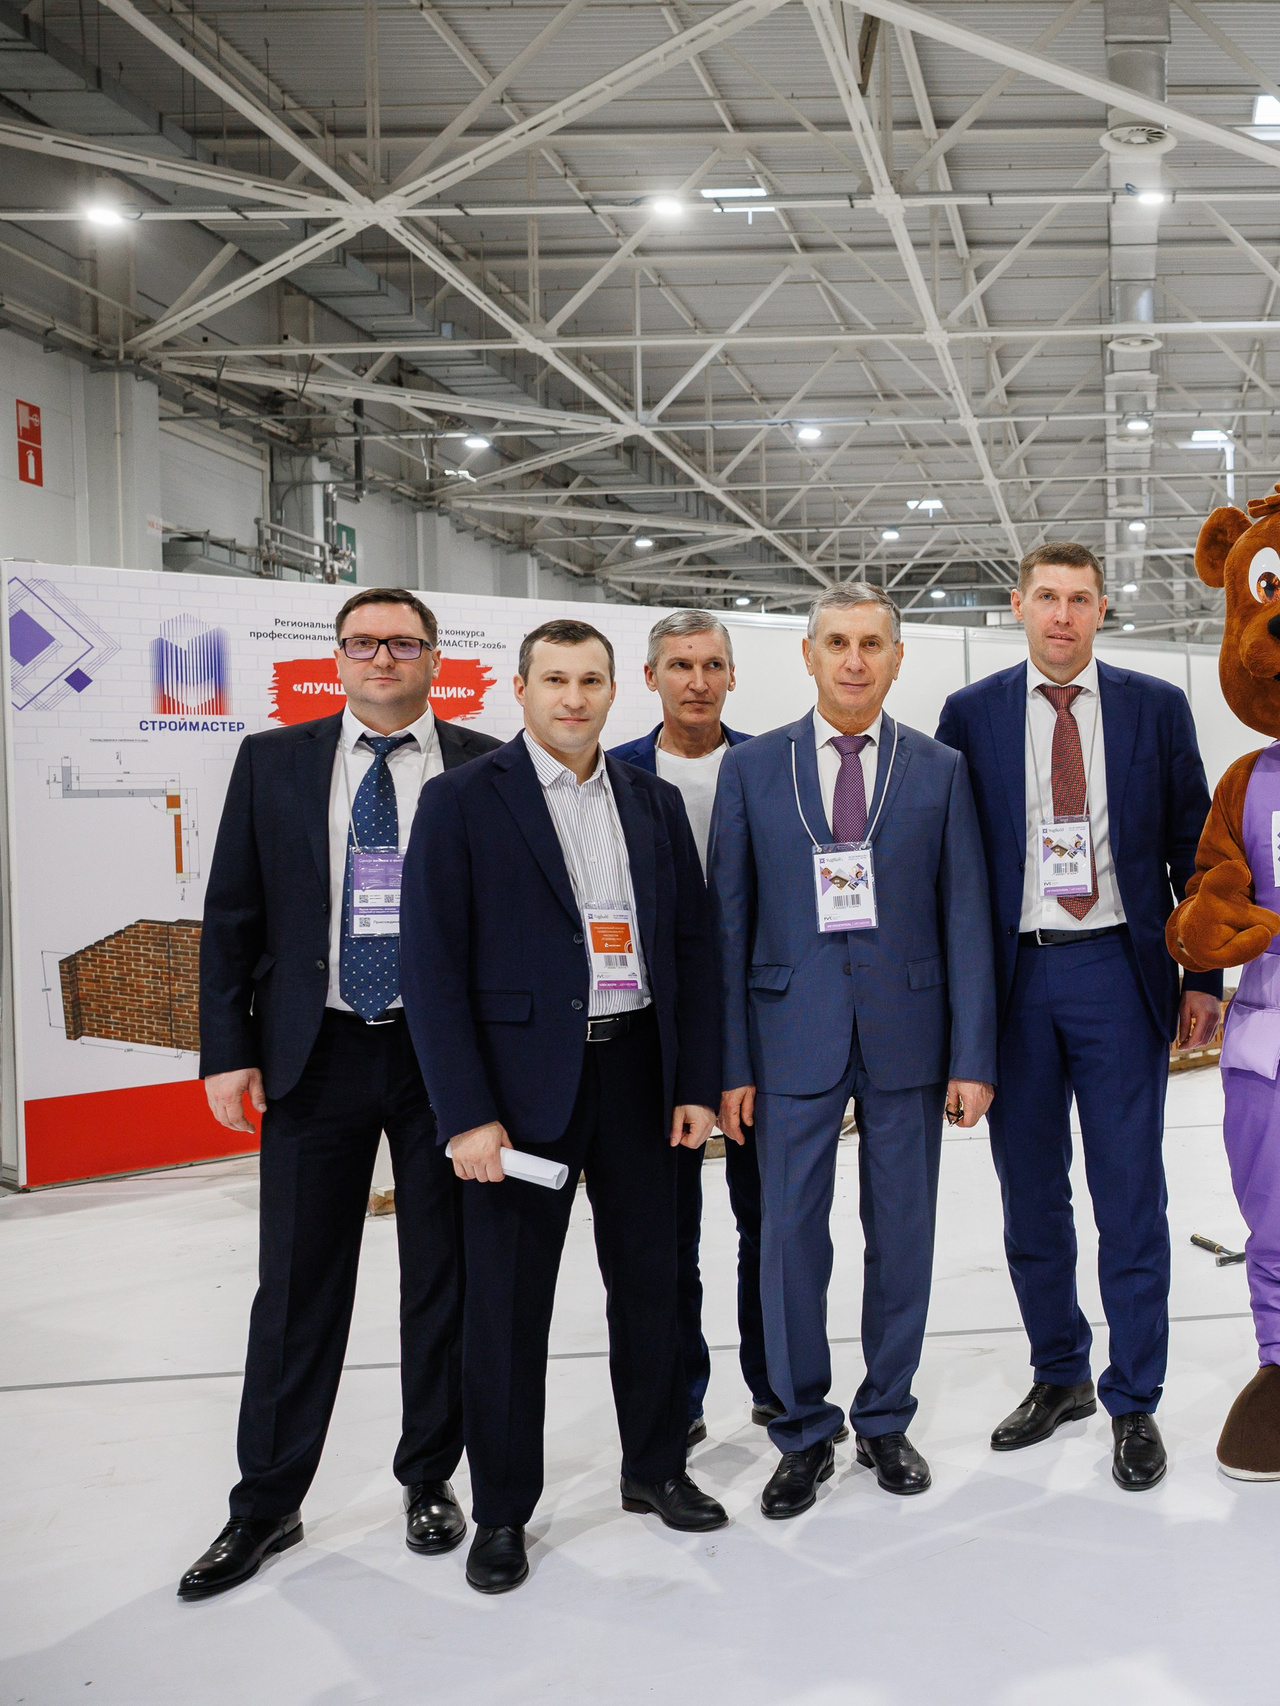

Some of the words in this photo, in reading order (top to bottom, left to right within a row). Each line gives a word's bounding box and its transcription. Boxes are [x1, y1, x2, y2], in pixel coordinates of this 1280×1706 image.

[445, 629, 485, 639] конкурса
[437, 637, 507, 649] ЙМАСТЕР-2026»
[292, 682, 347, 695] «ЛУЧШ
[428, 686, 476, 700] ЩИК»
[139, 718, 245, 732] СТРОЙМАСТЕР
